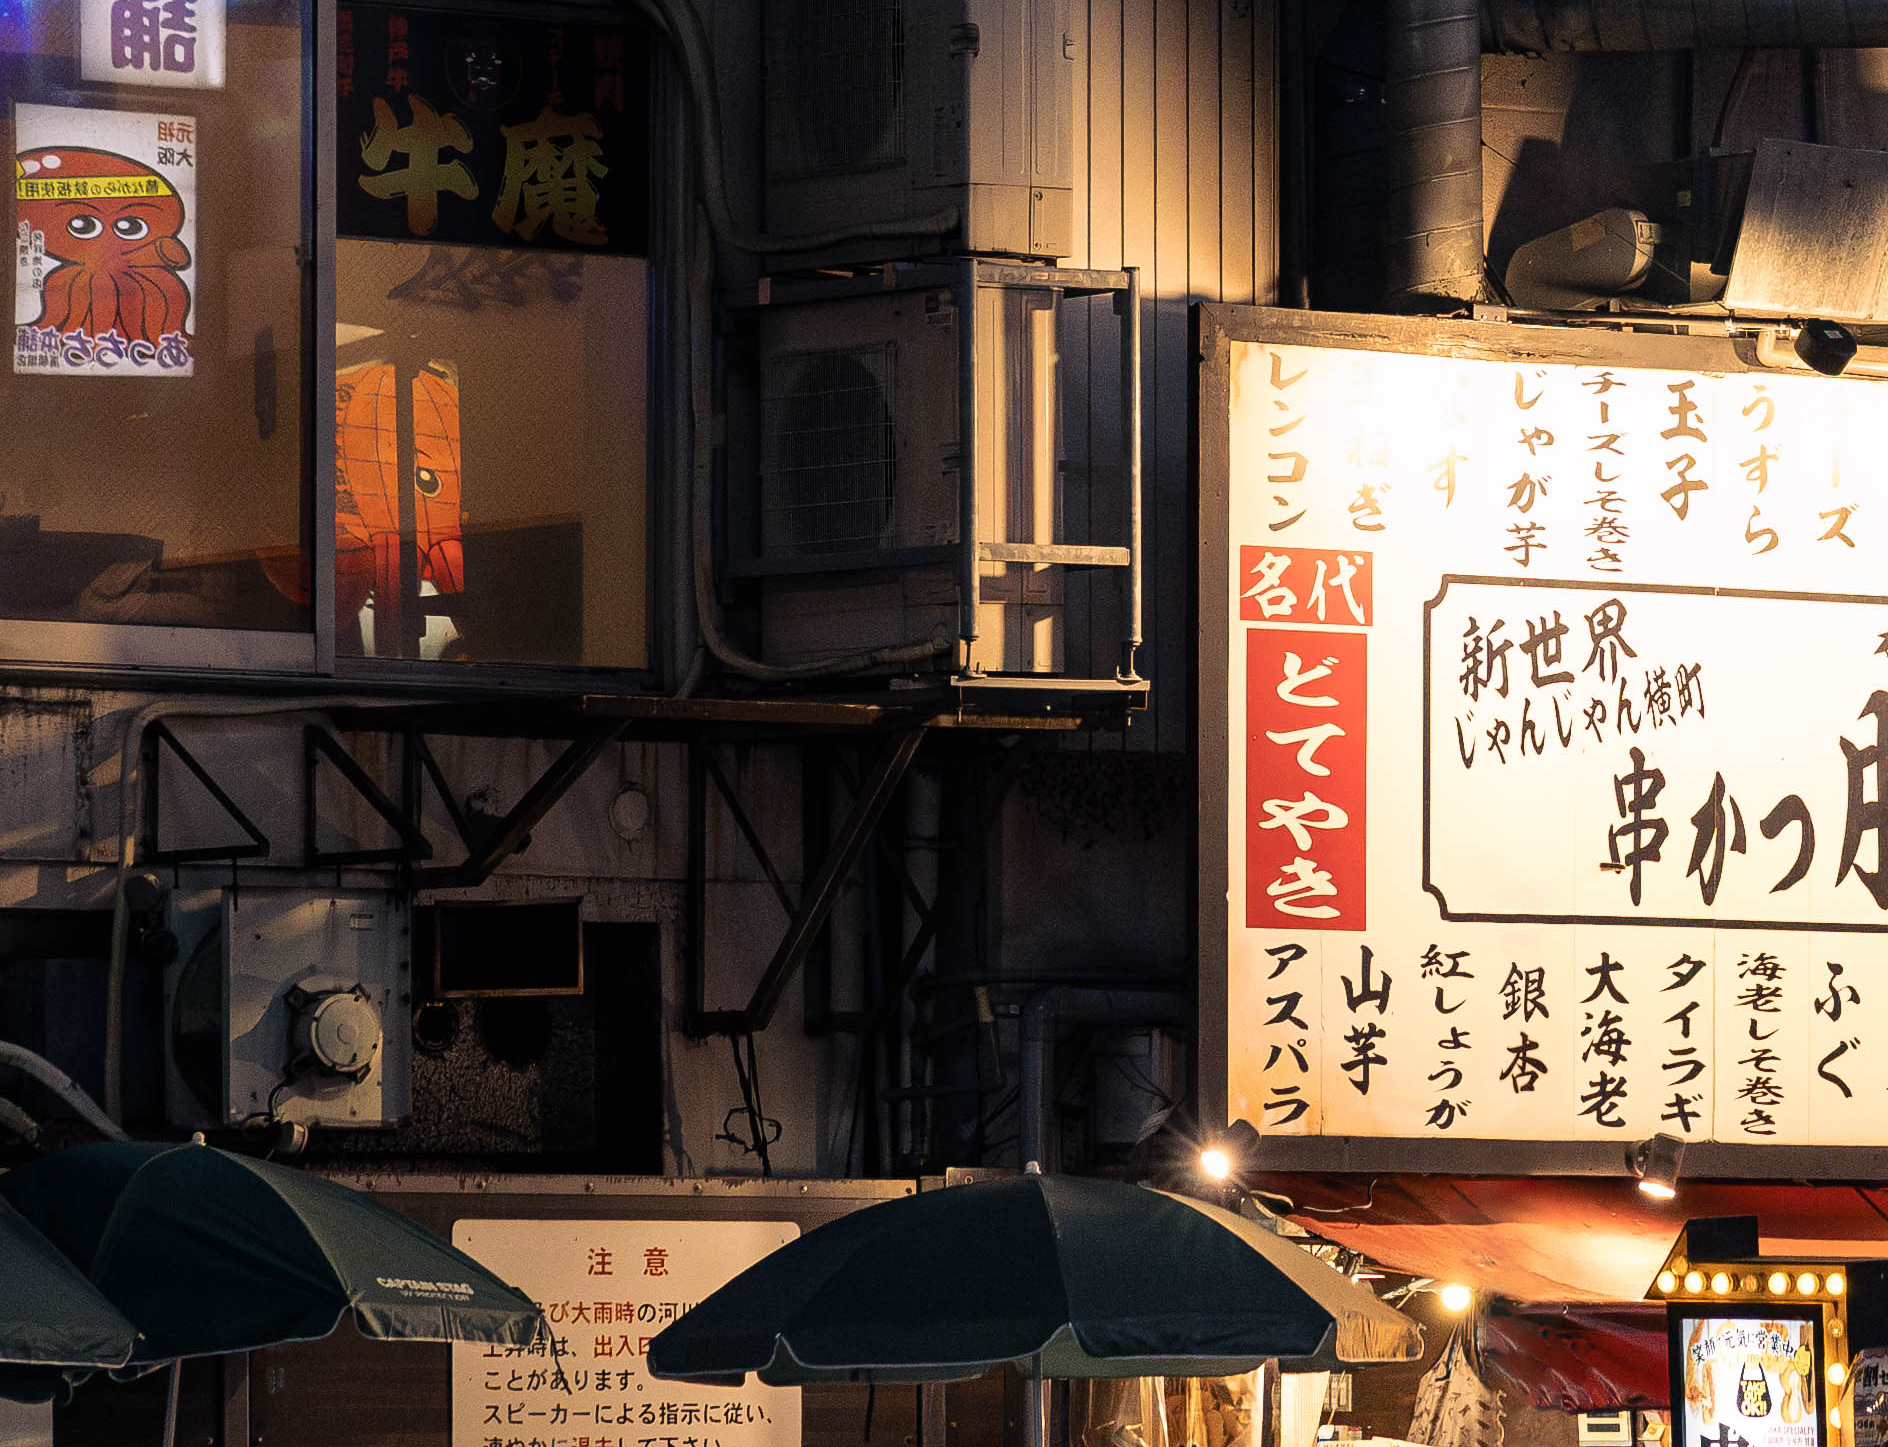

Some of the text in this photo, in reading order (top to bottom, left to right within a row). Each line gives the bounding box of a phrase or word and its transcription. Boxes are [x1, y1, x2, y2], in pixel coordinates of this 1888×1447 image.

[1267, 351, 1309, 533] レンコン
[1504, 369, 1556, 568] じゃが芋
[1581, 370, 1632, 573] チーズしそ巻き
[1660, 379, 1709, 520] 玉子
[1738, 385, 1781, 556] うずら
[1240, 551, 1368, 623] 名代
[1459, 597, 1638, 703] 新世界
[1258, 650, 1349, 920] どてやき
[1454, 661, 1707, 769] じゃんじゃん横町
[1261, 942, 1311, 1127] アスパラ
[1339, 944, 1393, 1096] 山芋
[1420, 943, 1476, 1130] 紅しょうが
[1496, 961, 1551, 1095] 銀杏
[1578, 951, 1633, 1129] 大海老
[1658, 952, 1708, 1133] タイラギ
[1736, 951, 1788, 1137] 海老しそ巻き
[1812, 960, 1862, 1101] ふぐ
[587, 1247, 671, 1276] 注意
[482, 1369, 645, 1393] ことがあります。
[482, 1401, 773, 1426] スピーカーによる指示に従い、
[1740, 1380, 1767, 1393] TAKE
[1744, 1391, 1765, 1403] OUT
